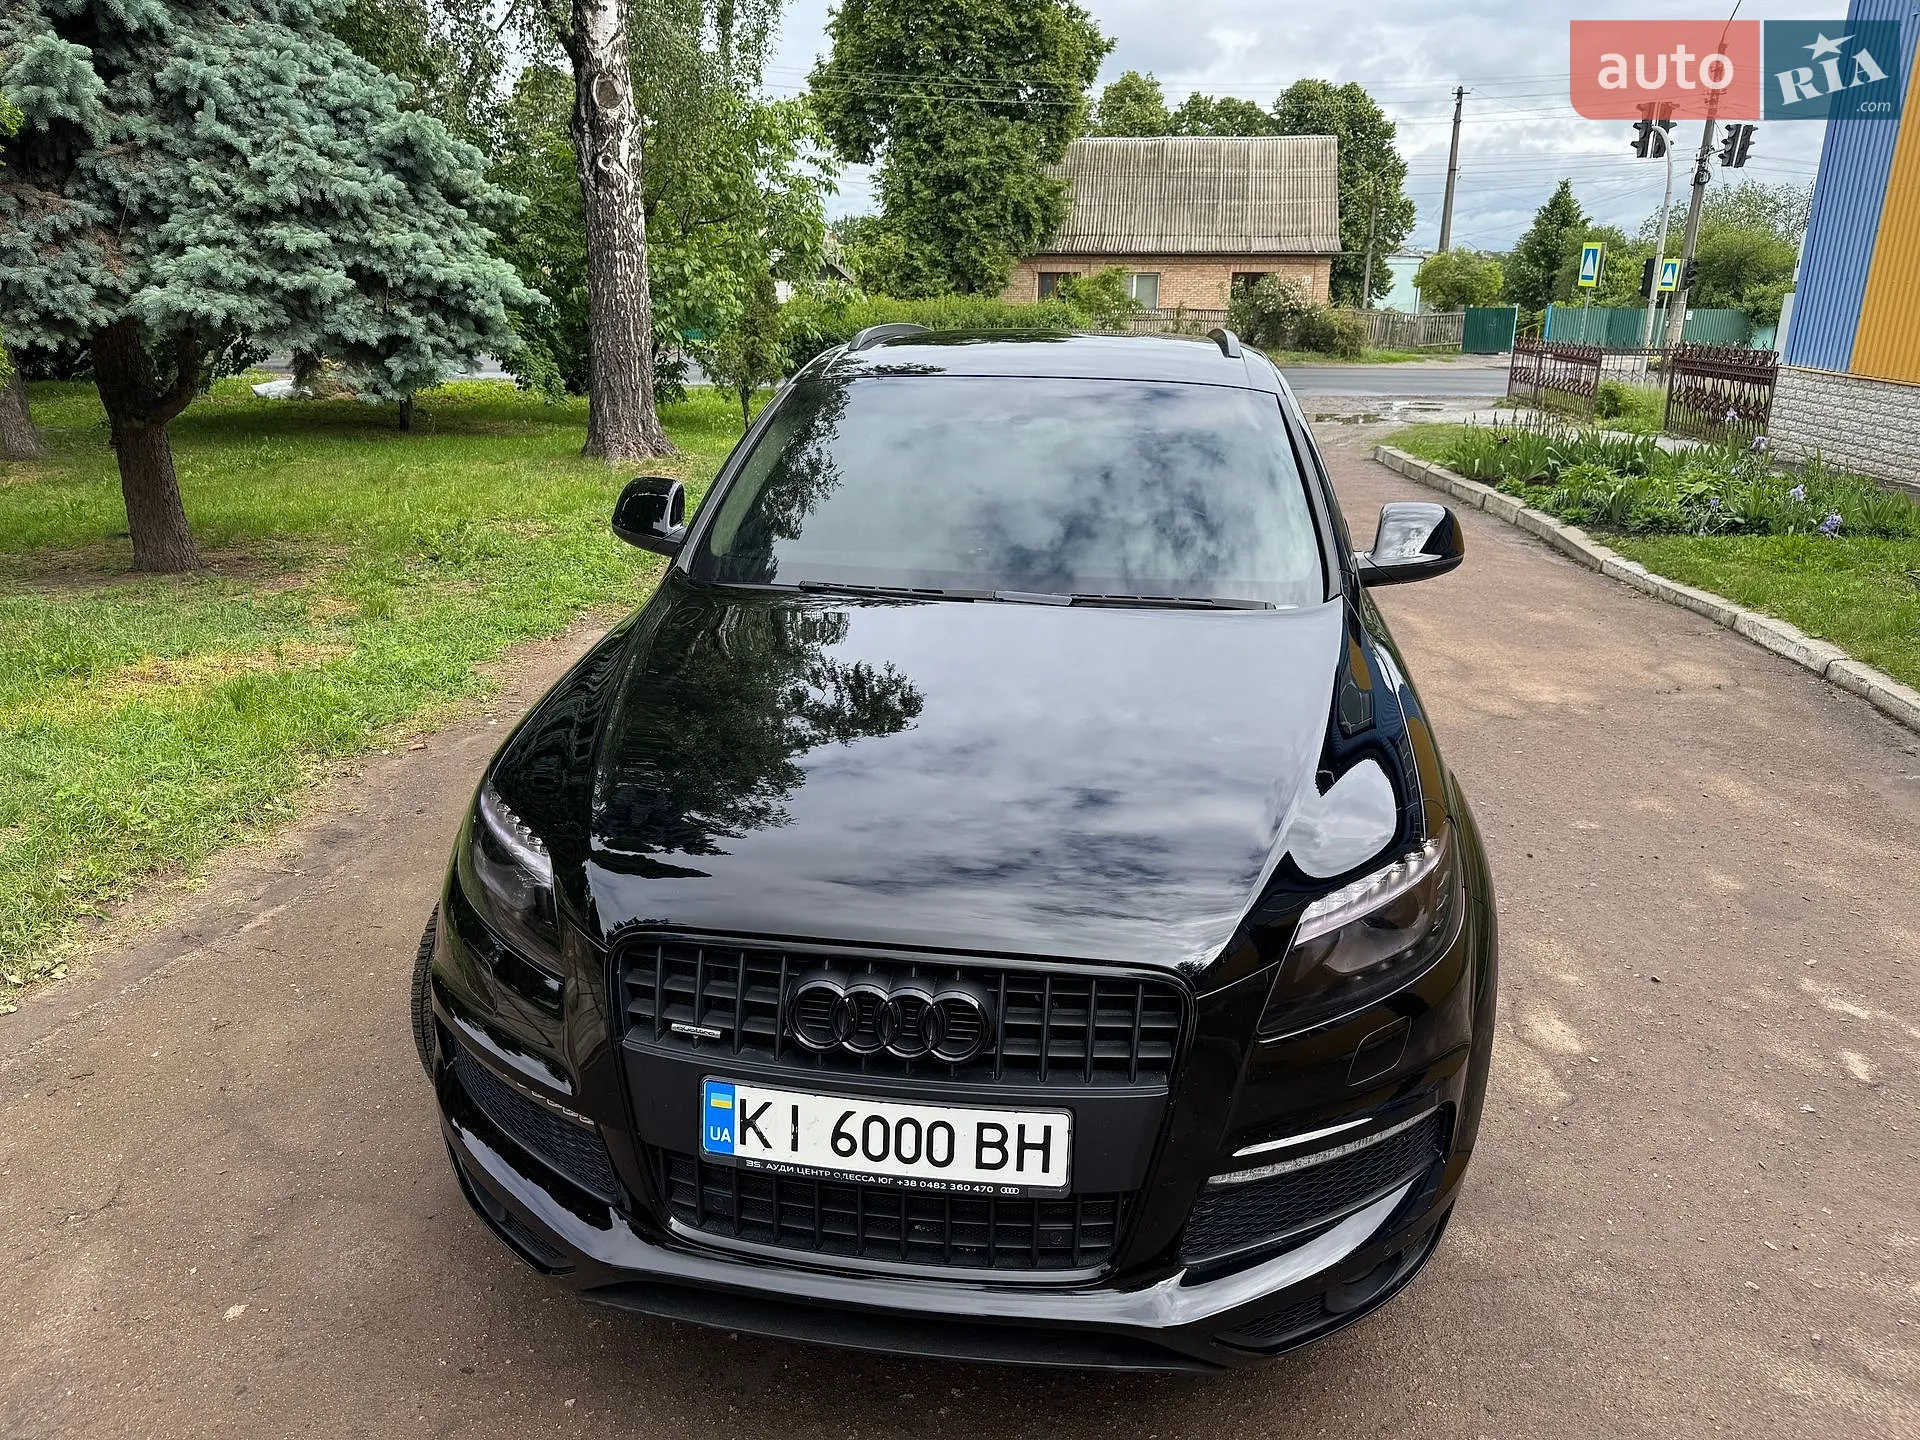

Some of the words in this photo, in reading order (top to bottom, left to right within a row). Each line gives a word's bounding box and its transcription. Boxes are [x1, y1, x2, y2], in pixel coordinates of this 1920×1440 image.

[709, 1125, 732, 1143] UA
[739, 1098, 799, 1152] KI
[830, 1110, 955, 1168] 6000
[975, 1121, 1052, 1174] BH
[766, 1163, 794, 1173] АУДИ
[797, 1167, 831, 1177] ЦЕНТР
[896, 1179, 917, 1187] +38
[919, 1180, 947, 1190] 0482
[949, 1183, 971, 1191] 360
[972, 1185, 994, 1193] 470
